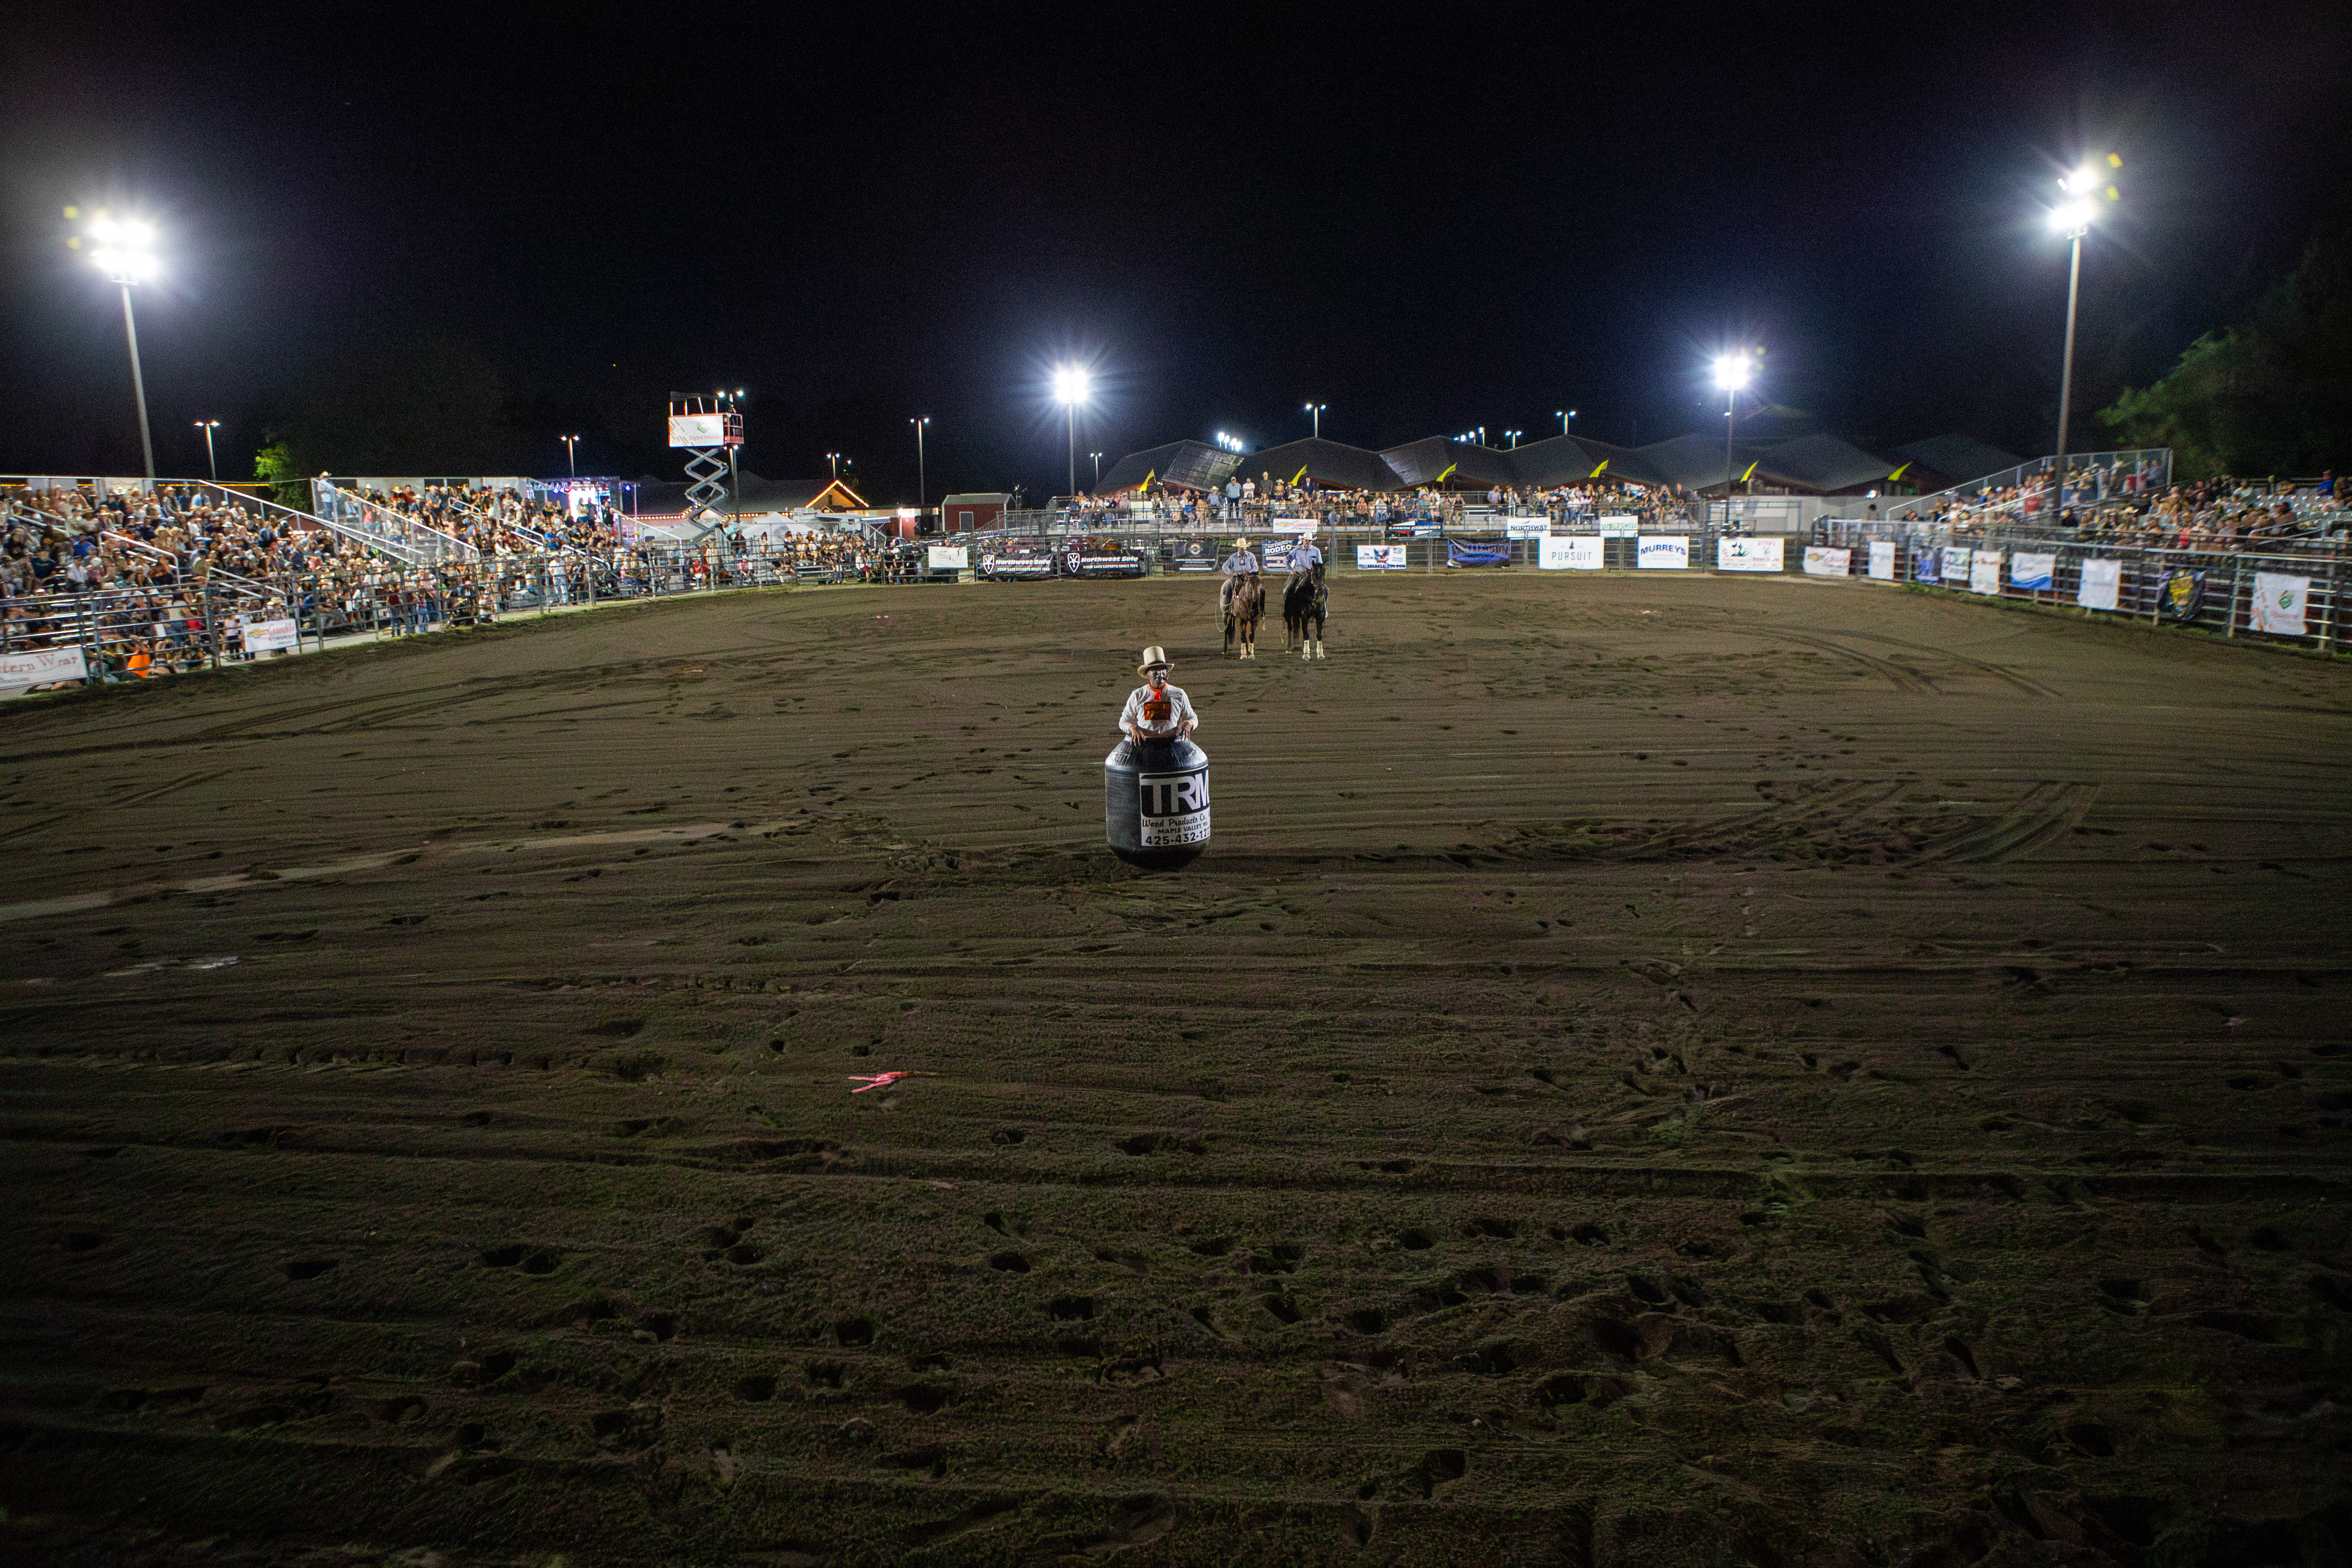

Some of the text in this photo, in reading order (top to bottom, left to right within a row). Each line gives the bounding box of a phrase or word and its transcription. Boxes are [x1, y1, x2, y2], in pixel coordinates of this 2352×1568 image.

[1292, 521, 1316, 530] Gamblin
[1265, 544, 1292, 554] RODEO
[1552, 552, 1592, 560] PURSUIT
[1139, 769, 1210, 814] TRM
[1142, 819, 1164, 827] Wood
[1169, 816, 1197, 827] Products
